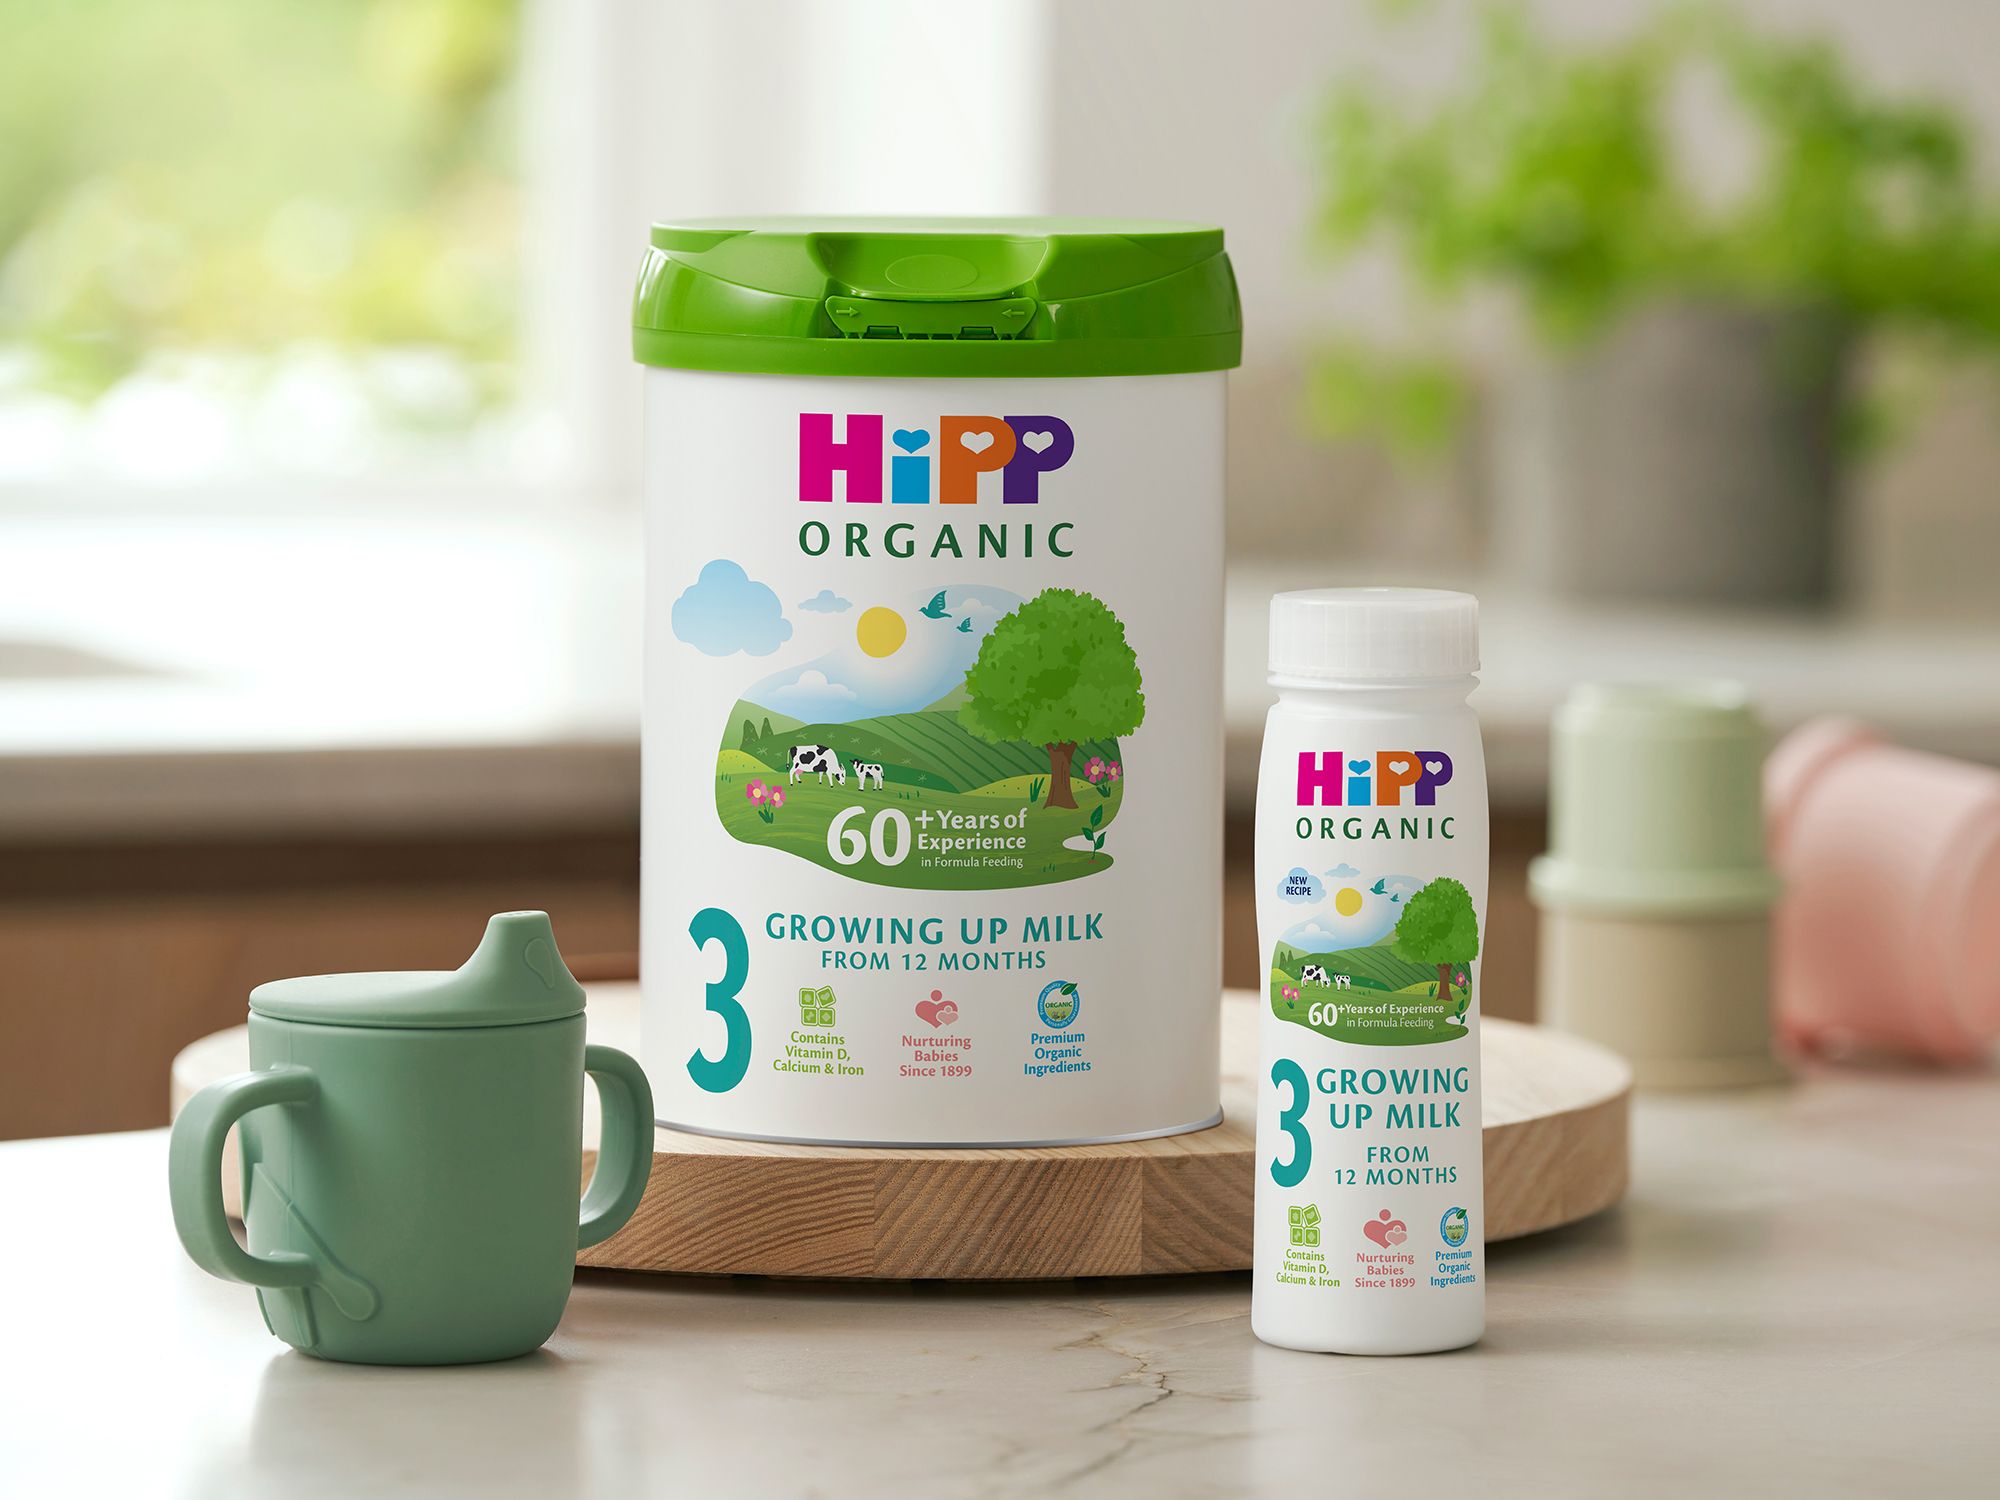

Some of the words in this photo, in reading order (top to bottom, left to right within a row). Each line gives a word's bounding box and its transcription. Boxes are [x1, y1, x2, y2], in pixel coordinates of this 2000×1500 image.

[799, 413, 1075, 505] HiPP
[798, 520, 1075, 558] ORGANIC
[1297, 751, 1453, 806] HiPP
[937, 810, 998, 829] Years
[1004, 808, 1027, 828] of
[1296, 817, 1454, 840] ORGANIC
[918, 833, 1026, 854] Experience
[920, 856, 932, 868] in
[934, 855, 980, 869] Formula
[982, 855, 1024, 870] Feeding
[1288, 875, 1308, 886] NEW
[1285, 885, 1312, 897] RECIPE
[765, 912, 943, 944] GROWING
[960, 918, 1008, 945] UP
[1023, 912, 1104, 943] MILK
[821, 950, 890, 970] FROM
[901, 952, 927, 971] 12
[938, 951, 1047, 971] MONTHS
[686, 907, 752, 1093] 3
[1345, 1003, 1374, 1014] Years
[1375, 1003, 1387, 1014] of
[1389, 1003, 1445, 1017] Experience
[1346, 1017, 1356, 1028] in
[1357, 1017, 1398, 1029] Formula
[1399, 1017, 1435, 1030] Feeding
[790, 1030, 846, 1046] Contains
[901, 1034, 973, 1051] Nurturing
[1031, 1030, 1086, 1045] Premium
[784, 1045, 834, 1061] Vitamin
[836, 1047, 852, 1063] D,
[914, 1049, 960, 1063] Babies
[1034, 1045, 1083, 1062] Organic
[772, 1058, 822, 1075] Calcium
[823, 1062, 835, 1075] &
[837, 1062, 865, 1077] Iron
[899, 1064, 937, 1078] Since
[940, 1064, 973, 1078] 1899
[1024, 1061, 1091, 1077] Ingredients
[1317, 1067, 1469, 1095] GROWING
[1271, 1059, 1312, 1187] 3
[1330, 1103, 1373, 1129] UP
[1386, 1102, 1461, 1129] MILK
[1367, 1146, 1429, 1163] FROM
[1335, 1169, 1357, 1185] 12
[1366, 1166, 1457, 1185] MONTHS
[1285, 1248, 1326, 1262] Contains
[1355, 1252, 1416, 1267] Nurturing
[1434, 1248, 1473, 1262] Premium
[1282, 1260, 1317, 1274] Vitamin
[1317, 1263, 1331, 1276] D,
[1366, 1263, 1405, 1276] Babies
[1437, 1261, 1471, 1276] Organic
[1275, 1272, 1308, 1287] Calcium
[1307, 1275, 1317, 1287] &
[1318, 1276, 1341, 1288] Iron
[1354, 1277, 1387, 1289] Since
[1388, 1277, 1417, 1289] 1899
[1429, 1273, 1477, 1289] Ingredients
